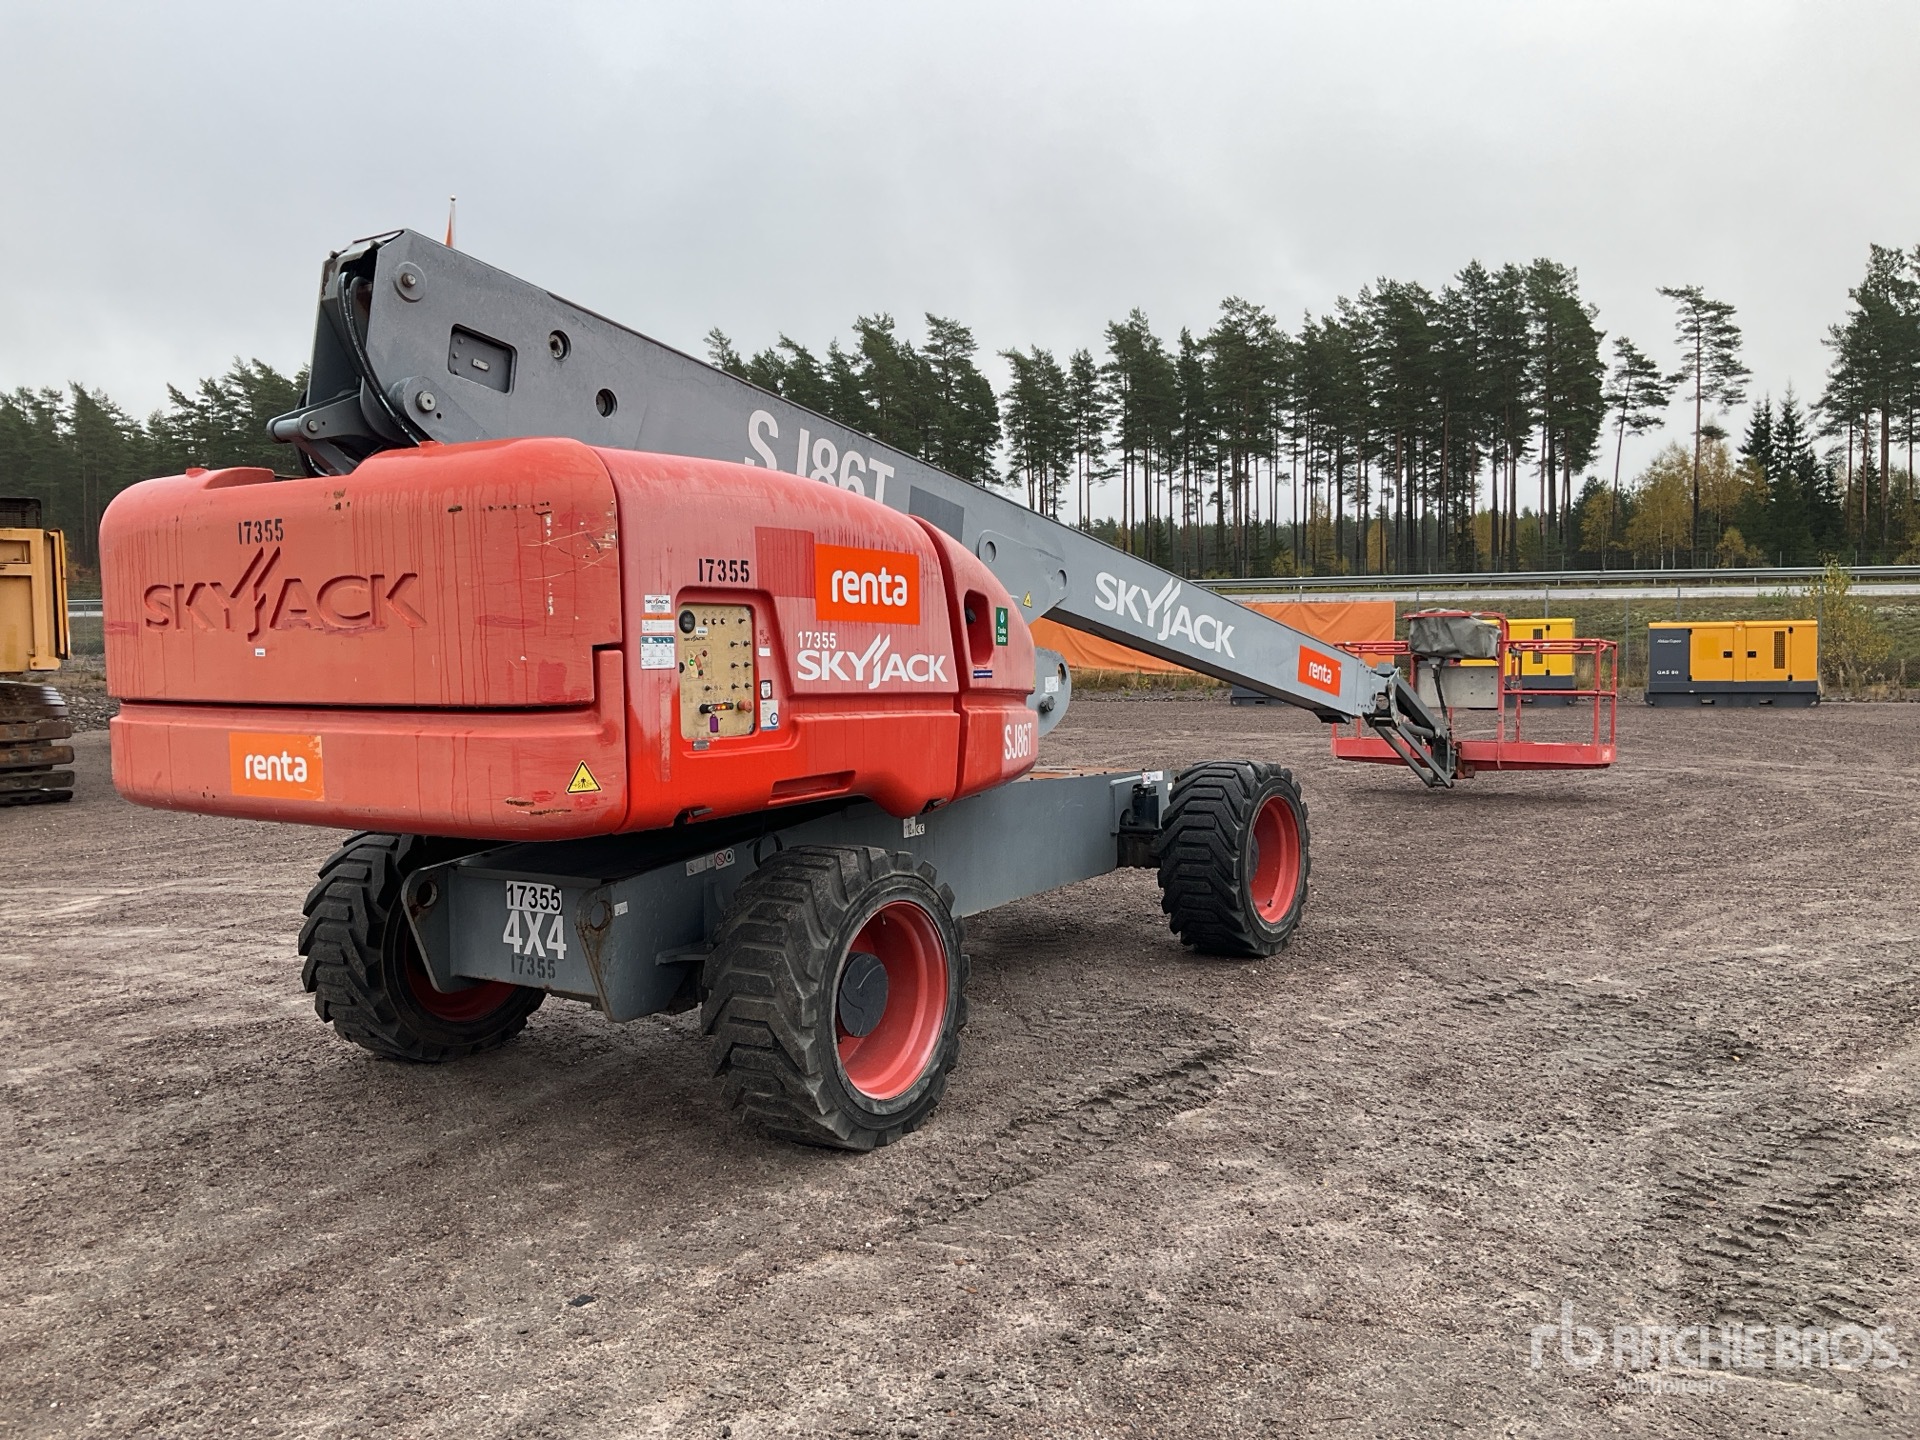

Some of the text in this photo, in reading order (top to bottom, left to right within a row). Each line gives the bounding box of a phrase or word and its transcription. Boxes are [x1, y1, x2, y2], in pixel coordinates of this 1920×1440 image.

[238, 518, 284, 545] 17355
[698, 558, 750, 583] 17355
[831, 566, 908, 607] renta
[143, 546, 428, 643] SKYJACK
[1094, 571, 1236, 659] SKYJACK
[797, 630, 837, 649] 17355
[797, 633, 949, 690] SKYJACK
[1308, 661, 1332, 685] renta
[1004, 722, 1033, 760] SJ86T
[244, 750, 308, 783] renta
[507, 883, 561, 912] 17355
[503, 910, 567, 960] 4X4
[511, 953, 556, 980] 17355
